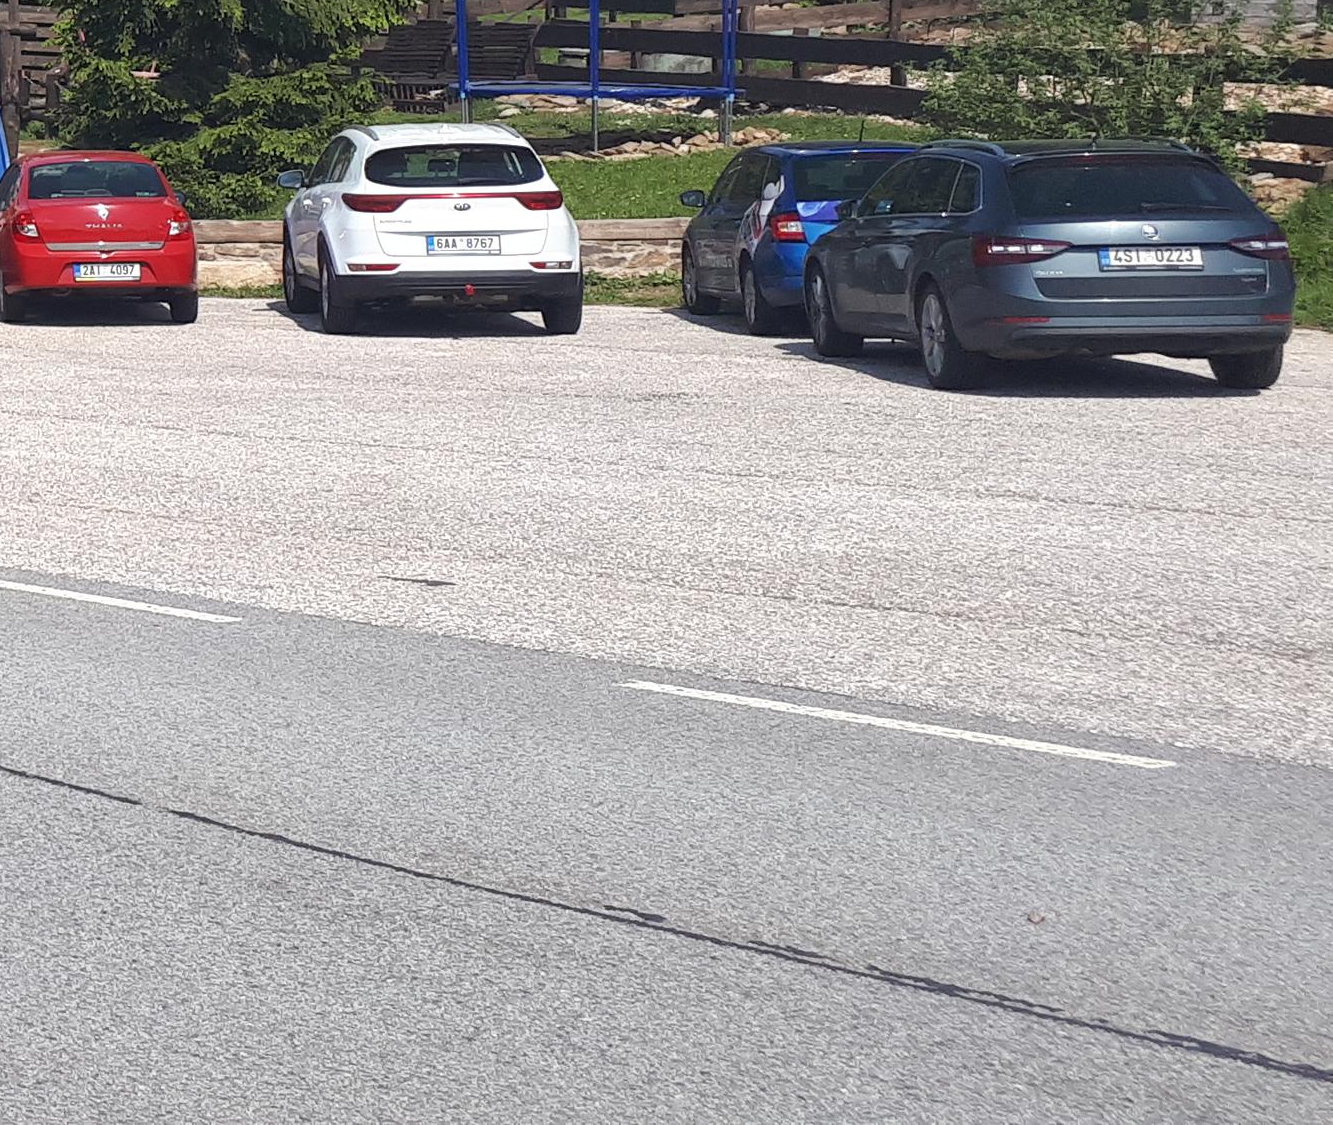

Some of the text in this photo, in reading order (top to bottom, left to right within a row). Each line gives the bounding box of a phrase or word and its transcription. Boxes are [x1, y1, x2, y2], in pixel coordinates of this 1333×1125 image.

[436, 237, 494, 249] 6AA 8767
[1155, 247, 1194, 263] 0223
[110, 264, 134, 275] 4097
